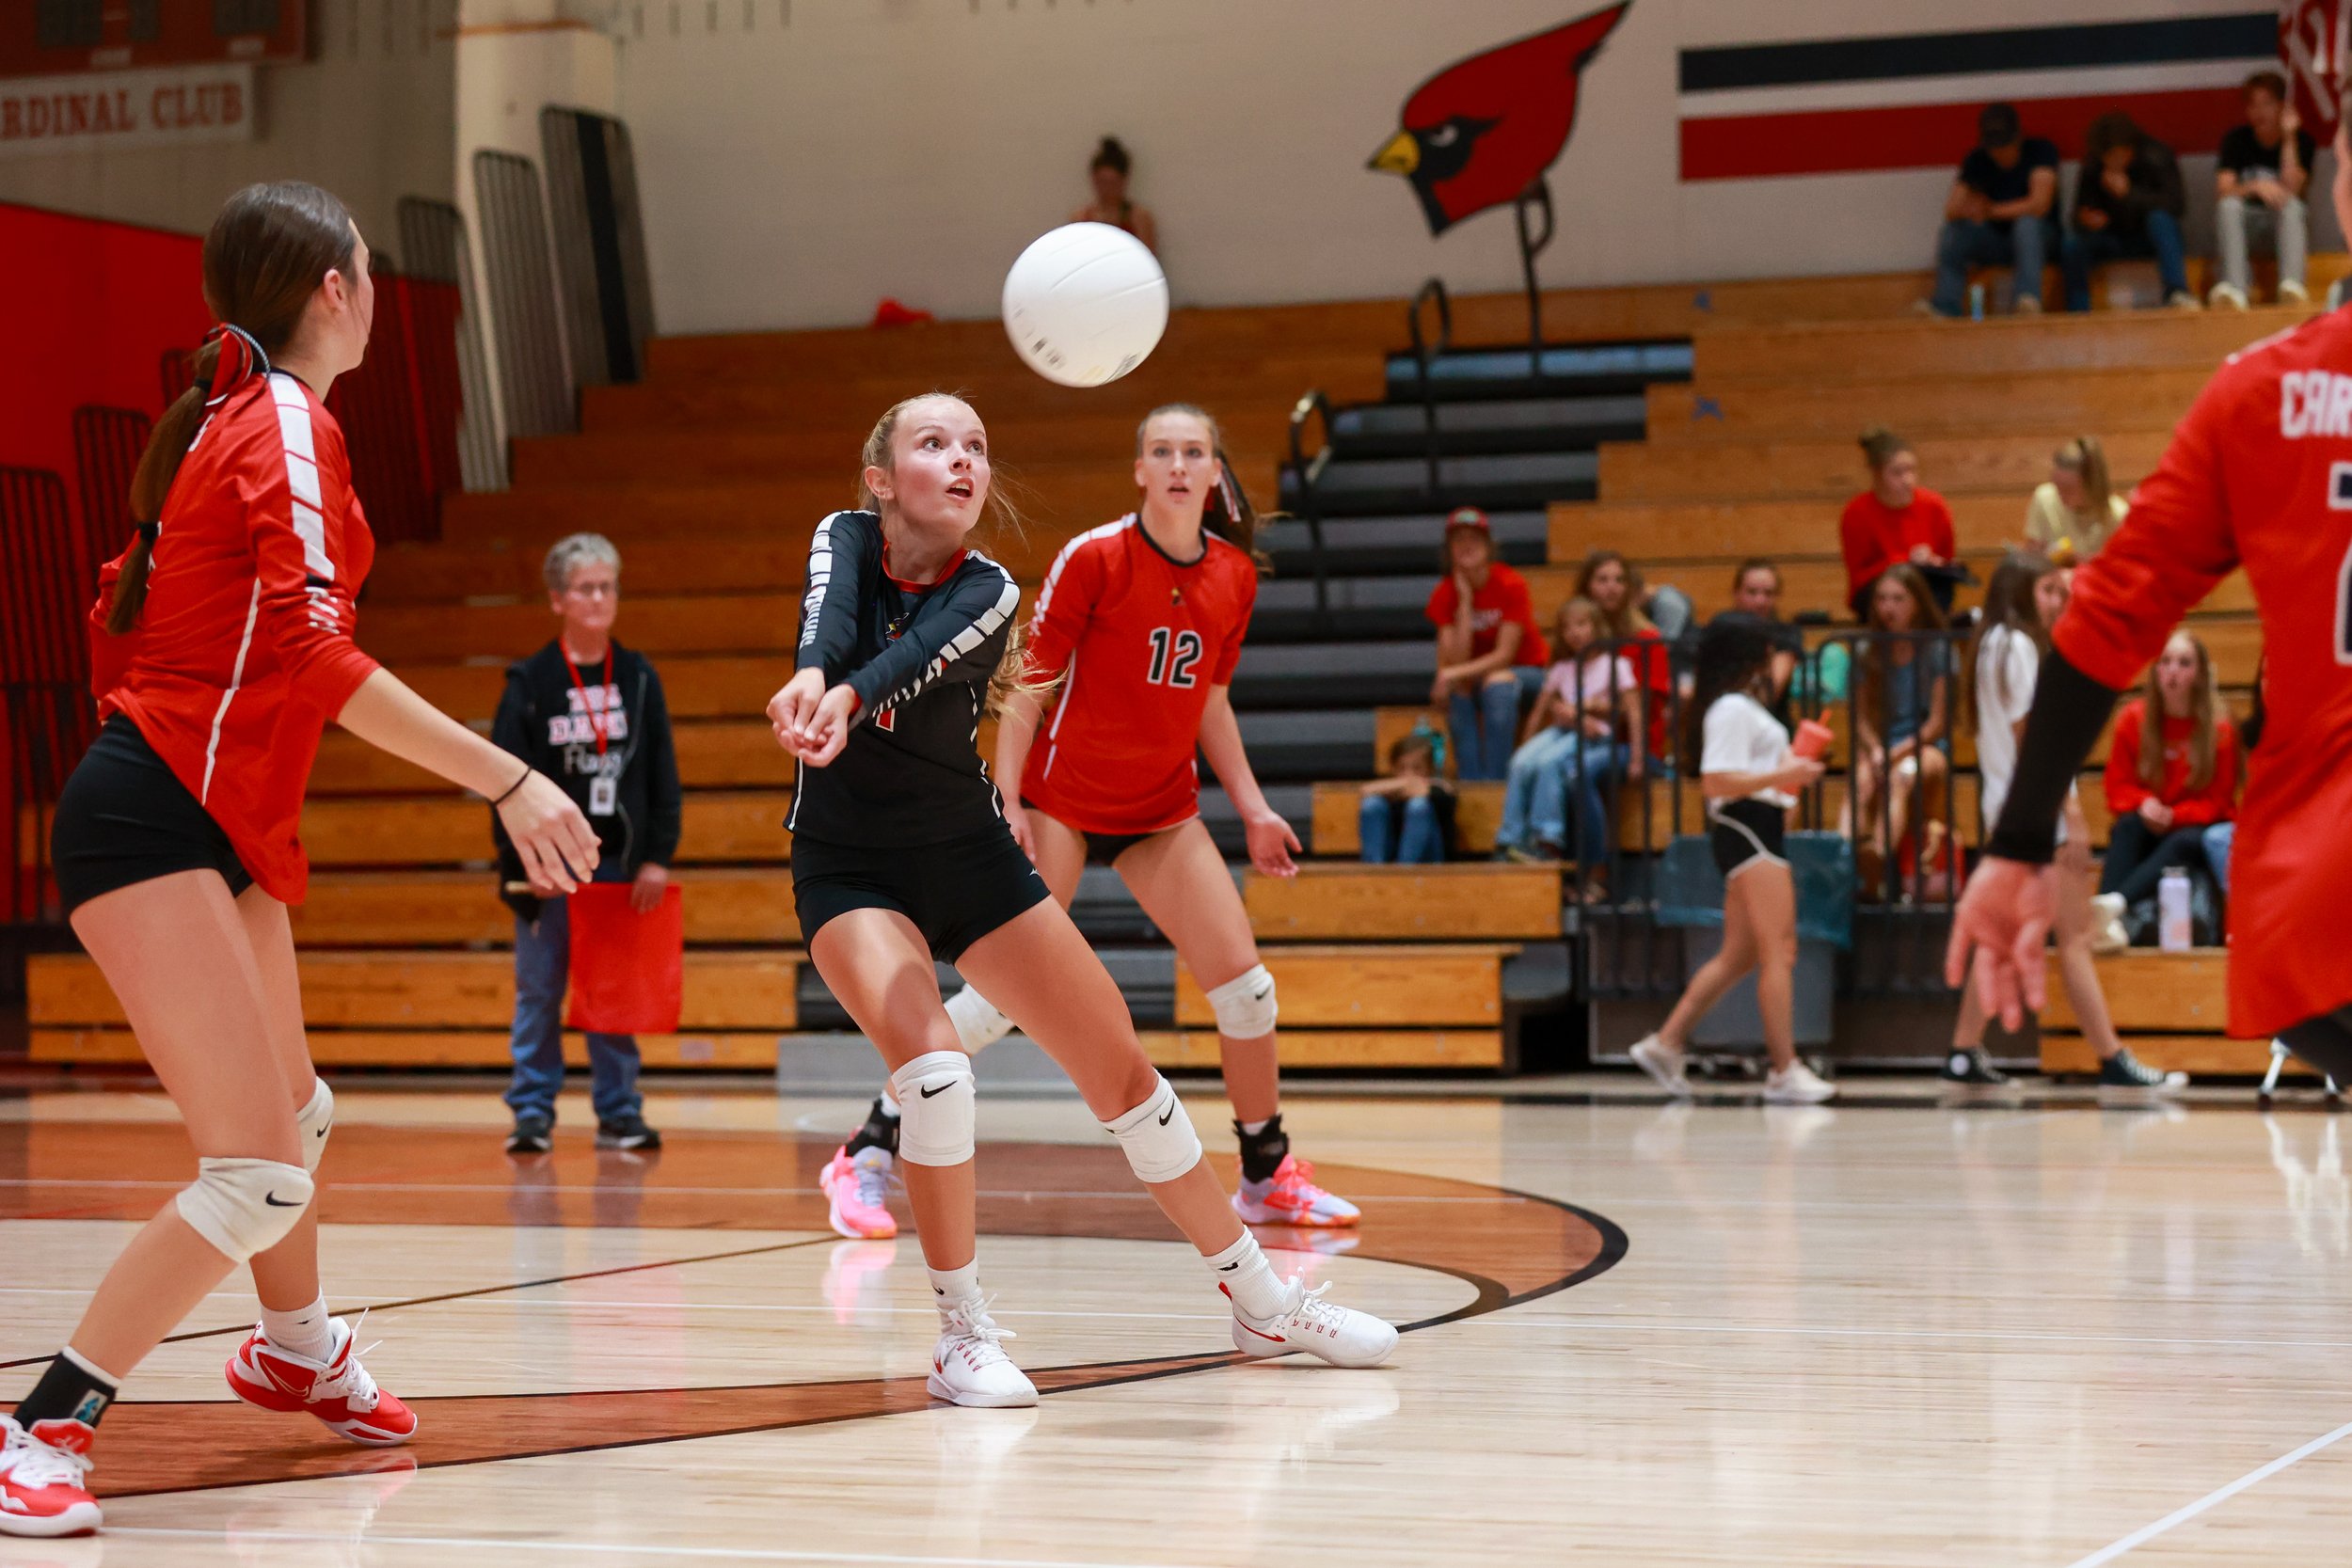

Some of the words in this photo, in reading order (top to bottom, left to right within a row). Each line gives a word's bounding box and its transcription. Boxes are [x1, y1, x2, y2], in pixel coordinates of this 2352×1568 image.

[1, 87, 139, 140] RDINAL
[151, 81, 244, 131] CLUB
[1146, 626, 1203, 689] 12
